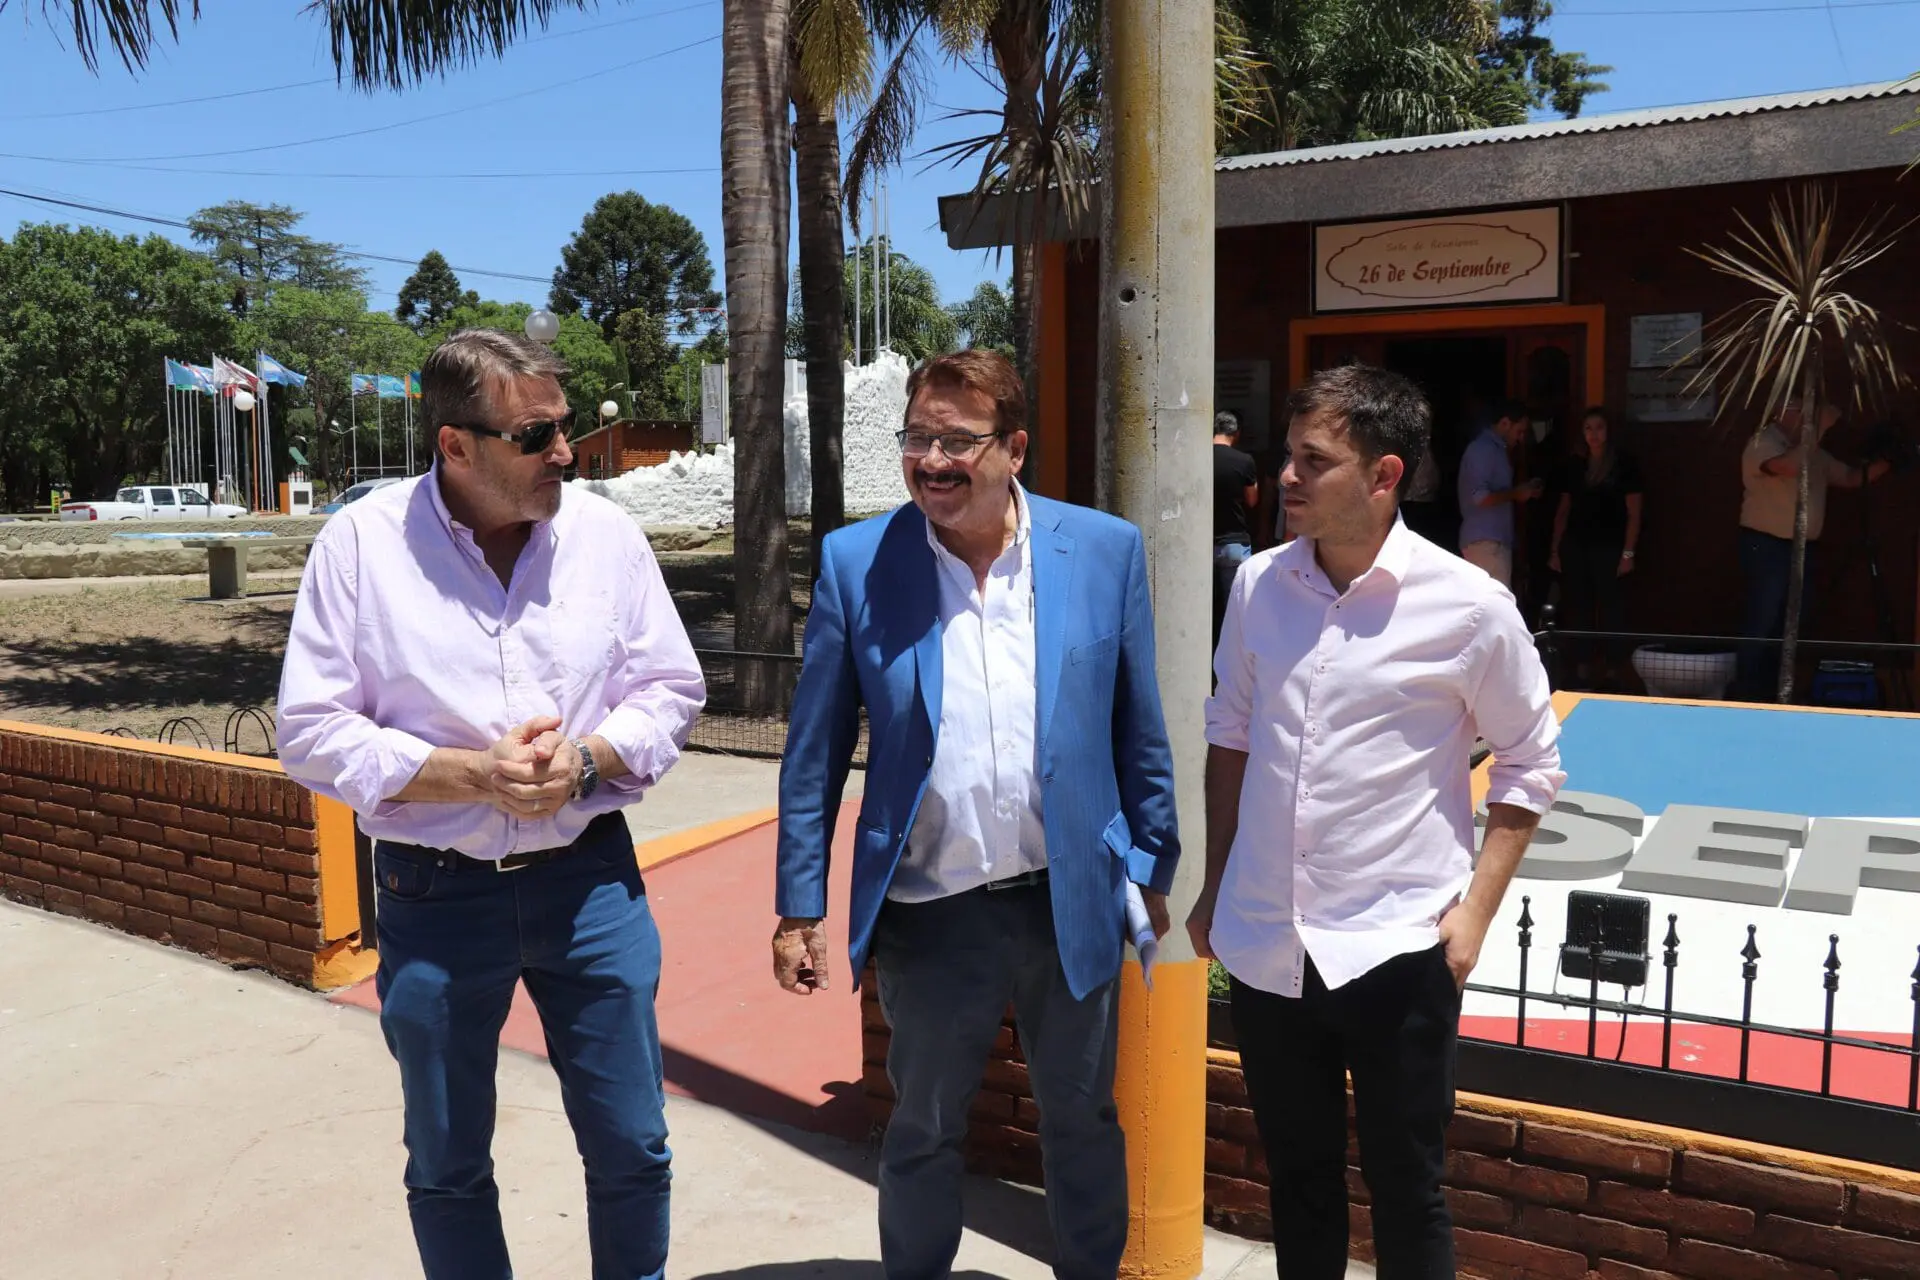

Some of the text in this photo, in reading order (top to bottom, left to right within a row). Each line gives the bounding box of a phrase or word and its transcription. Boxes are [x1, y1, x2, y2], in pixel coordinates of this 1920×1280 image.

[1414, 242, 1426, 252] de
[1359, 256, 1511, 284] 26 de Septiembre
